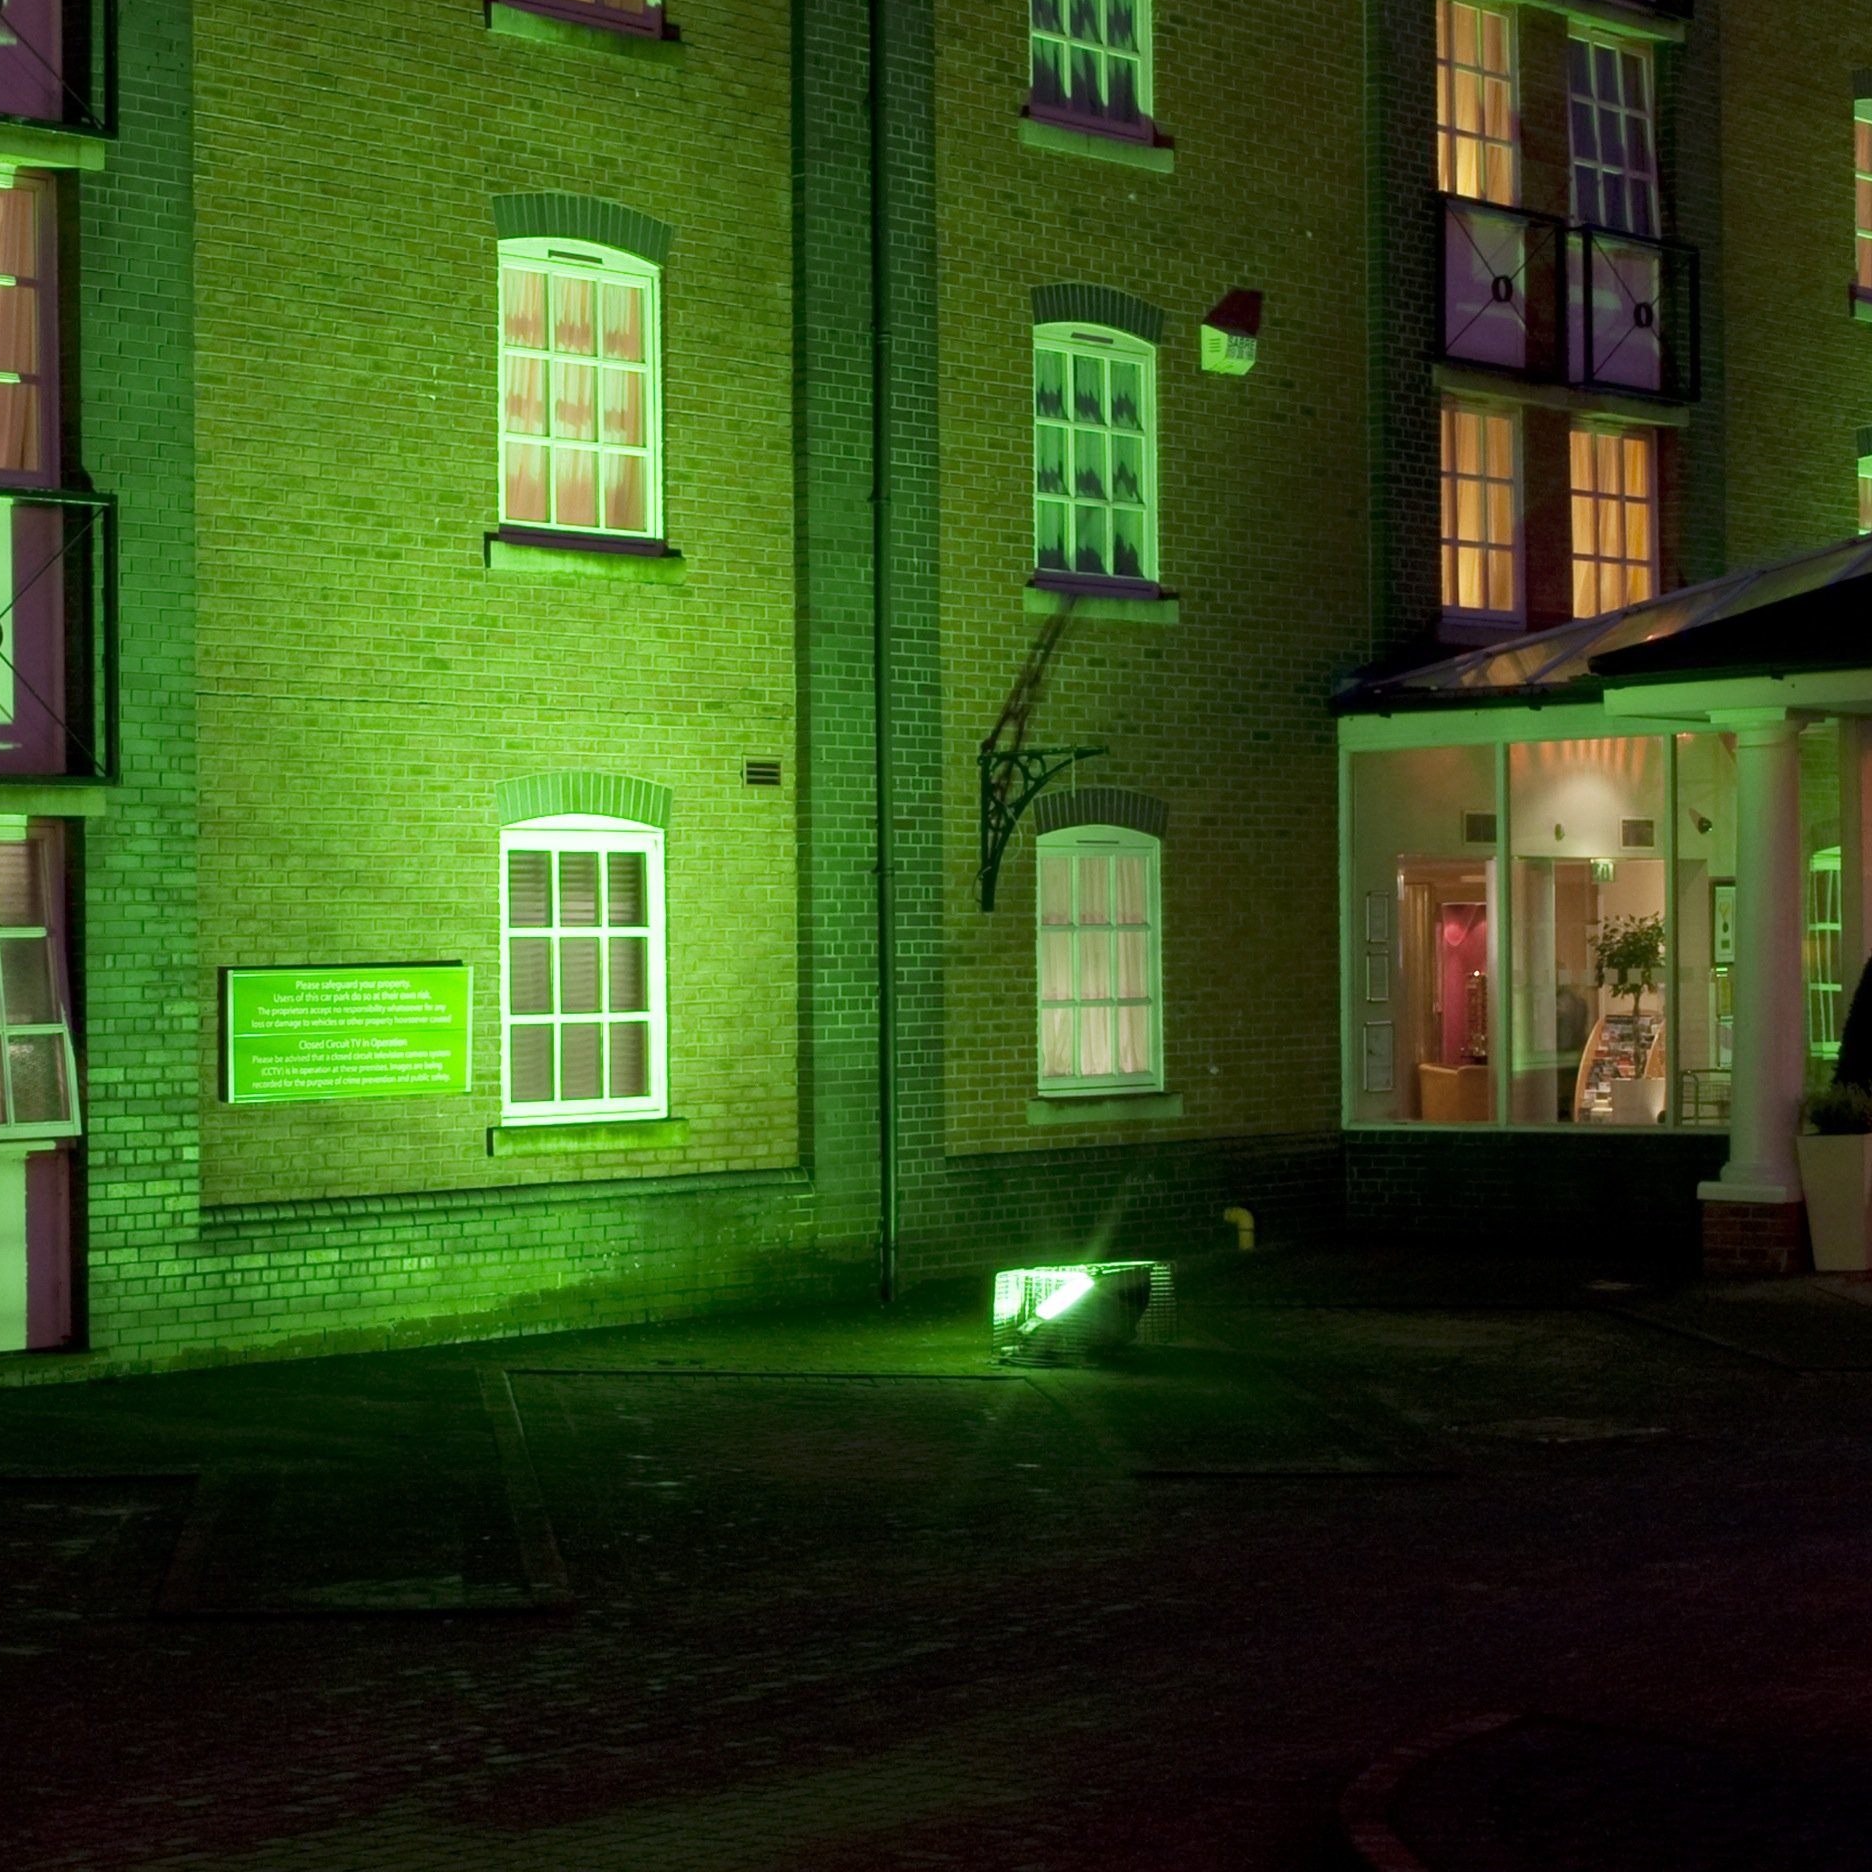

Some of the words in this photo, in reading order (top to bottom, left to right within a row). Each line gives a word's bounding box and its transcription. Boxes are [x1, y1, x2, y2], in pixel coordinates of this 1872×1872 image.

[296, 980, 320, 990] Please
[321, 980, 358, 991] safeguard
[360, 981, 375, 991] your
[273, 992, 295, 1003] Users
[295, 991, 304, 1002] of
[305, 992, 319, 1002] this
[320, 994, 332, 1002] car
[333, 991, 350, 1003] park
[351, 992, 362, 1000] do
[373, 992, 380, 1000] at
[382, 991, 398, 1000] their
[400, 992, 416, 1000] own
[257, 1007, 270, 1015] The
[271, 1007, 309, 1016] proprietors
[310, 1007, 332, 1016] accept
[343, 1004, 385, 1014] responsibility
[251, 1019, 264, 1028] loss
[274, 1019, 301, 1029] damage
[311, 1018, 337, 1026] vehicles
[346, 1017, 364, 1025] other
[365, 1017, 393, 1027] property
[299, 1039, 324, 1050] Closed
[326, 1039, 350, 1049] Circuit
[351, 1038, 361, 1048] TV
[362, 1039, 370, 1047] in
[371, 1037, 408, 1049] Operation
[252, 1055, 273, 1064] Please
[274, 1055, 283, 1063] be
[284, 1053, 310, 1062] advised
[311, 1052, 324, 1061] that
[331, 1052, 352, 1061] closed
[353, 1051, 372, 1060] circuit
[261, 1067, 284, 1076] (CCTV)
[285, 1067, 290, 1075] is
[291, 1066, 299, 1074] in
[299, 1067, 331, 1075] operation
[340, 1064, 357, 1072] these
[252, 1079, 282, 1088] recorded
[283, 1078, 293, 1087] for
[294, 1078, 305, 1087] the
[306, 1079, 333, 1088] purpose
[335, 1076, 342, 1085] of
[362, 1076, 396, 1086] prevention
[397, 1074, 409, 1082] and
[410, 1073, 430, 1083] public
